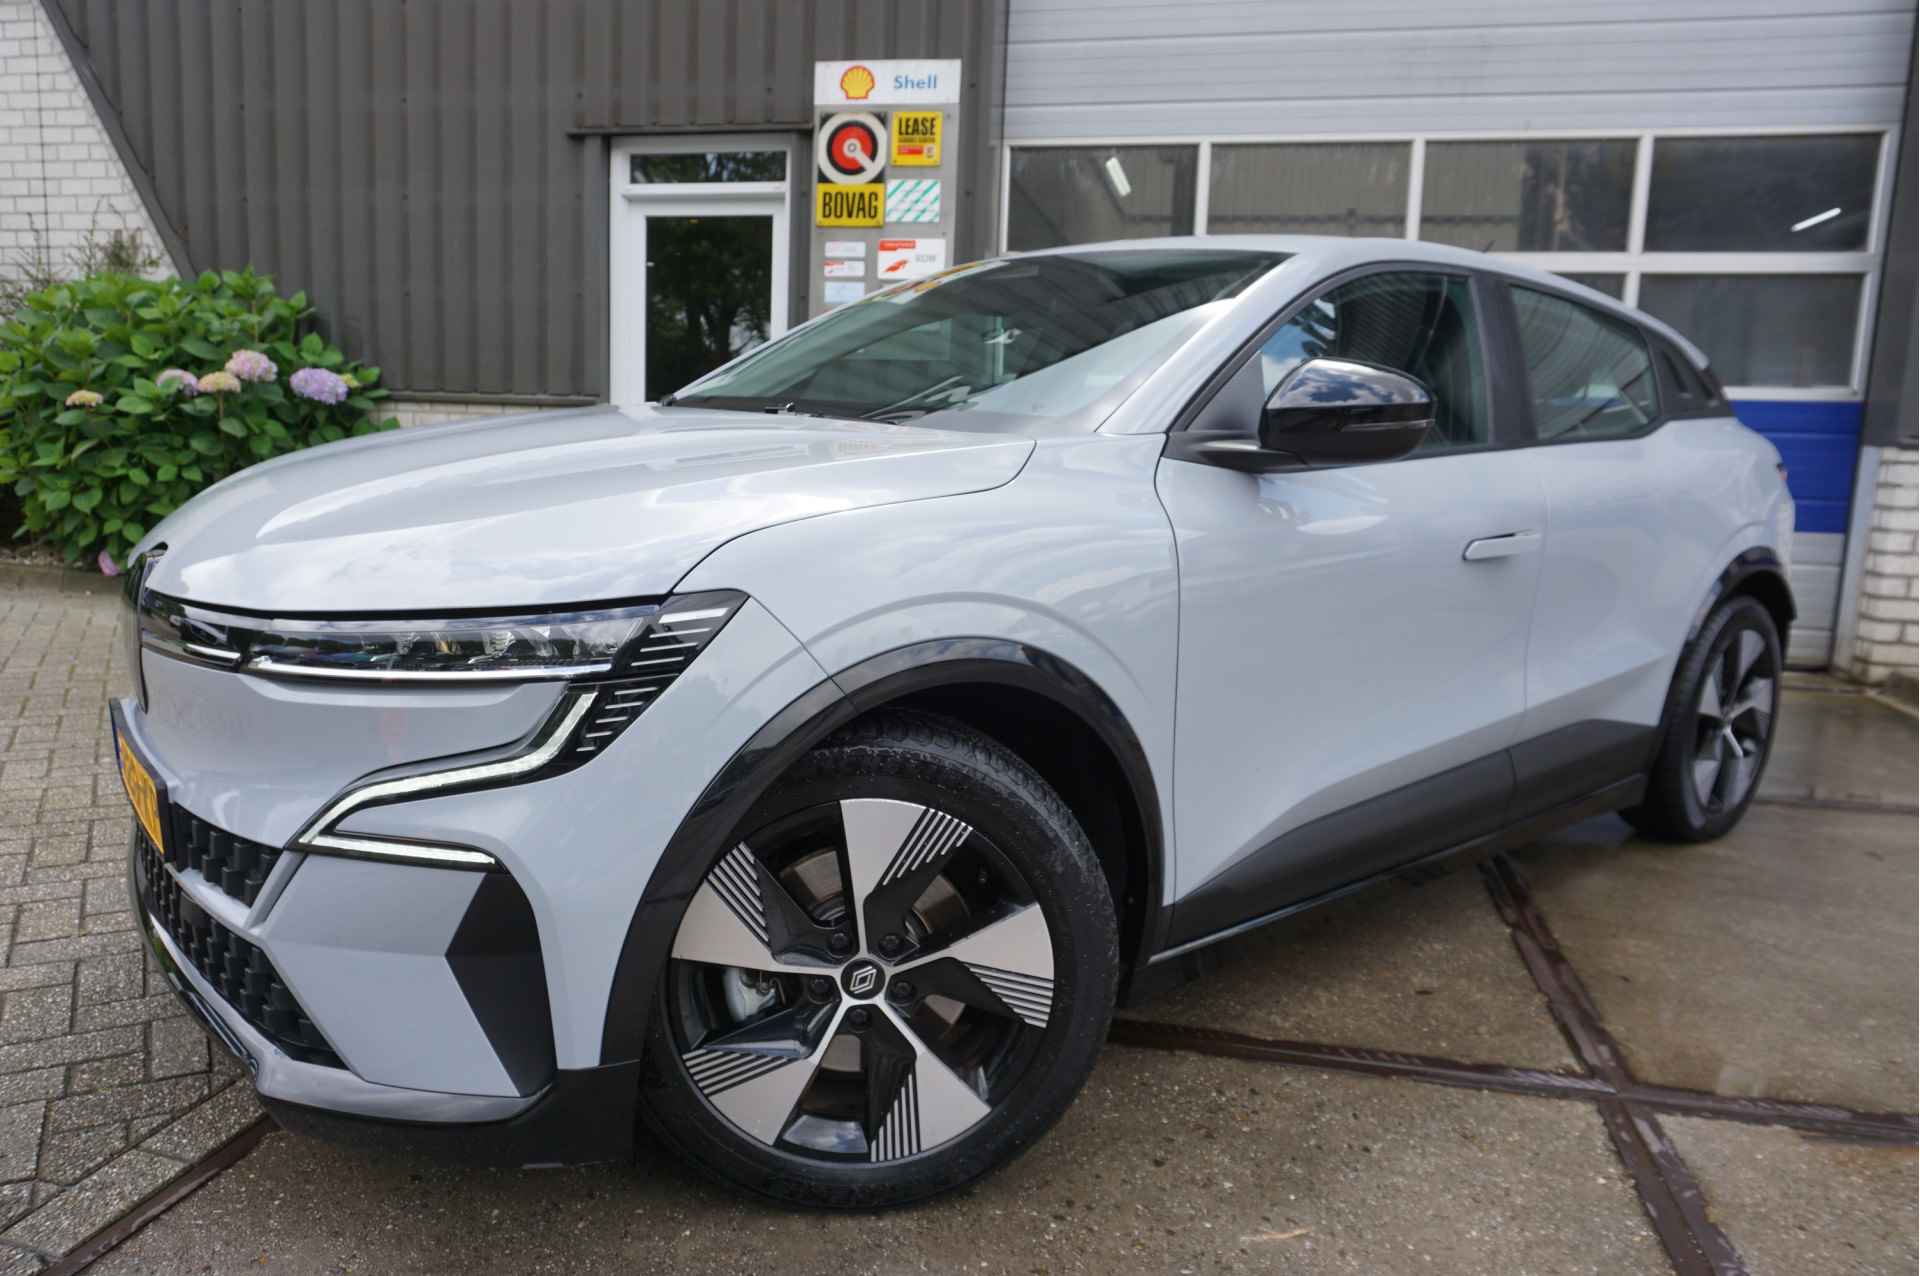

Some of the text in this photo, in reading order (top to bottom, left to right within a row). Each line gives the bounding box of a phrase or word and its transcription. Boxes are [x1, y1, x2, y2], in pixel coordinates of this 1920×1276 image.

[894, 74, 937, 89] Shell
[898, 117, 936, 136] LEASE
[822, 192, 878, 219] BOVAG
